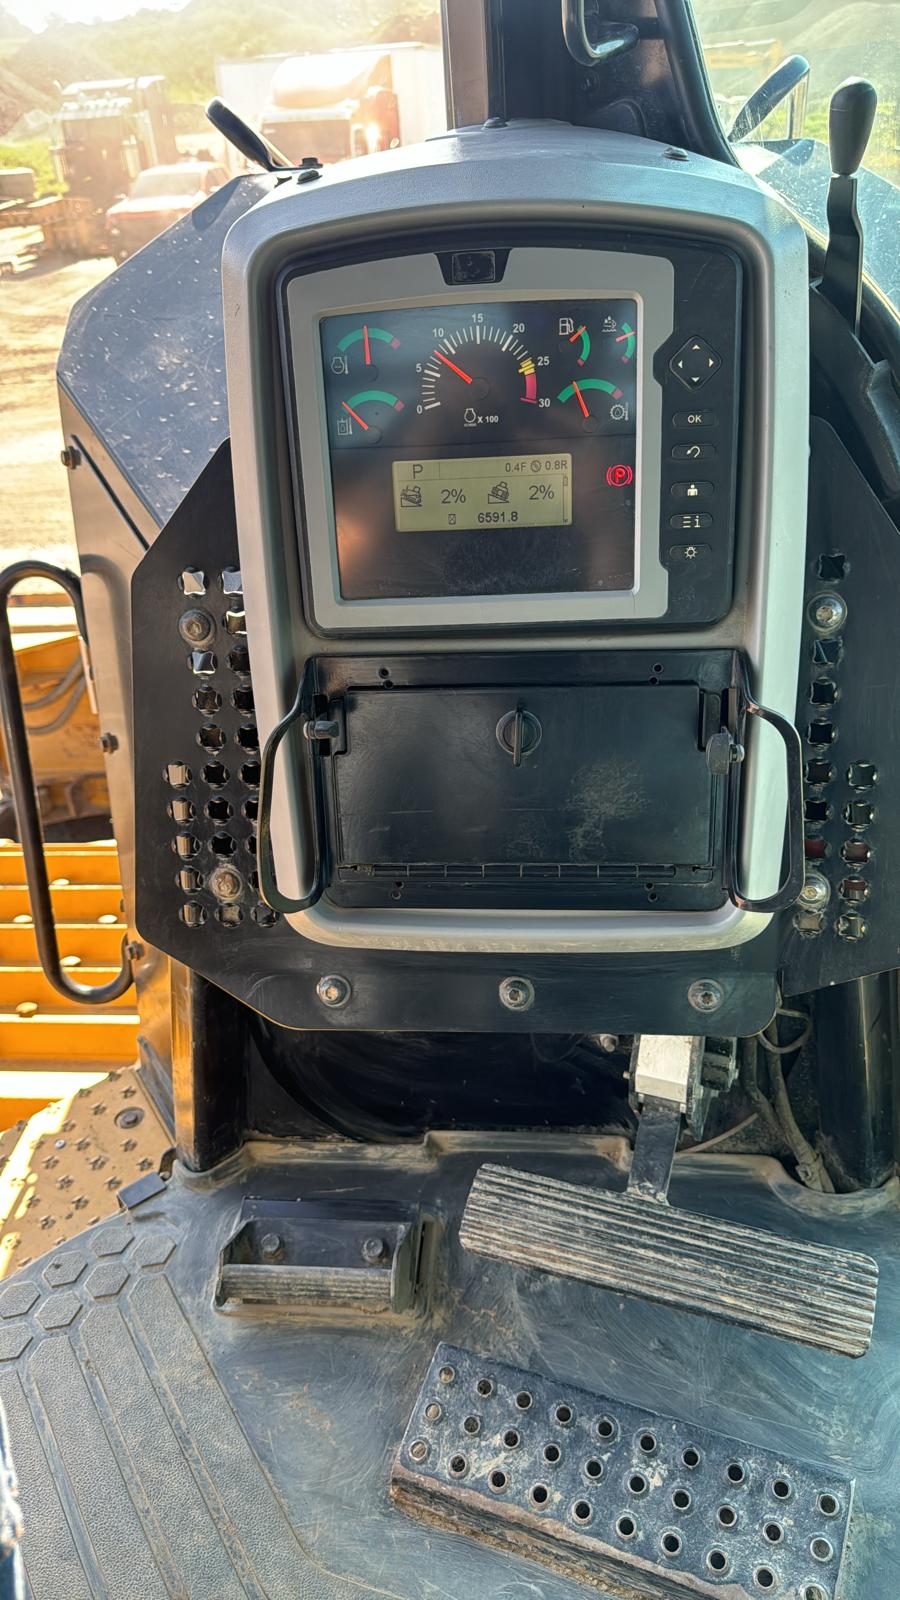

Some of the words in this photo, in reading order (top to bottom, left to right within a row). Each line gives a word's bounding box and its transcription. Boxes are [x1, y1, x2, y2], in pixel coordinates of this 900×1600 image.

[472, 313, 484, 323] 15
[433, 328, 444, 338] 10
[513, 323, 525, 334] 20
[537, 356, 550, 366] 25
[416, 364, 422, 373] 5
[538, 398, 551, 408] 30
[416, 405, 423, 414] 0
[485, 415, 499, 424] 100
[687, 414, 702, 424] OK
[412, 464, 424, 479] P
[505, 462, 527, 473] 0.4F
[545, 460, 568, 471] 0.8R
[440, 488, 466, 504] 2%
[528, 484, 555, 501] 2%
[477, 511, 518, 524] 6591.8
